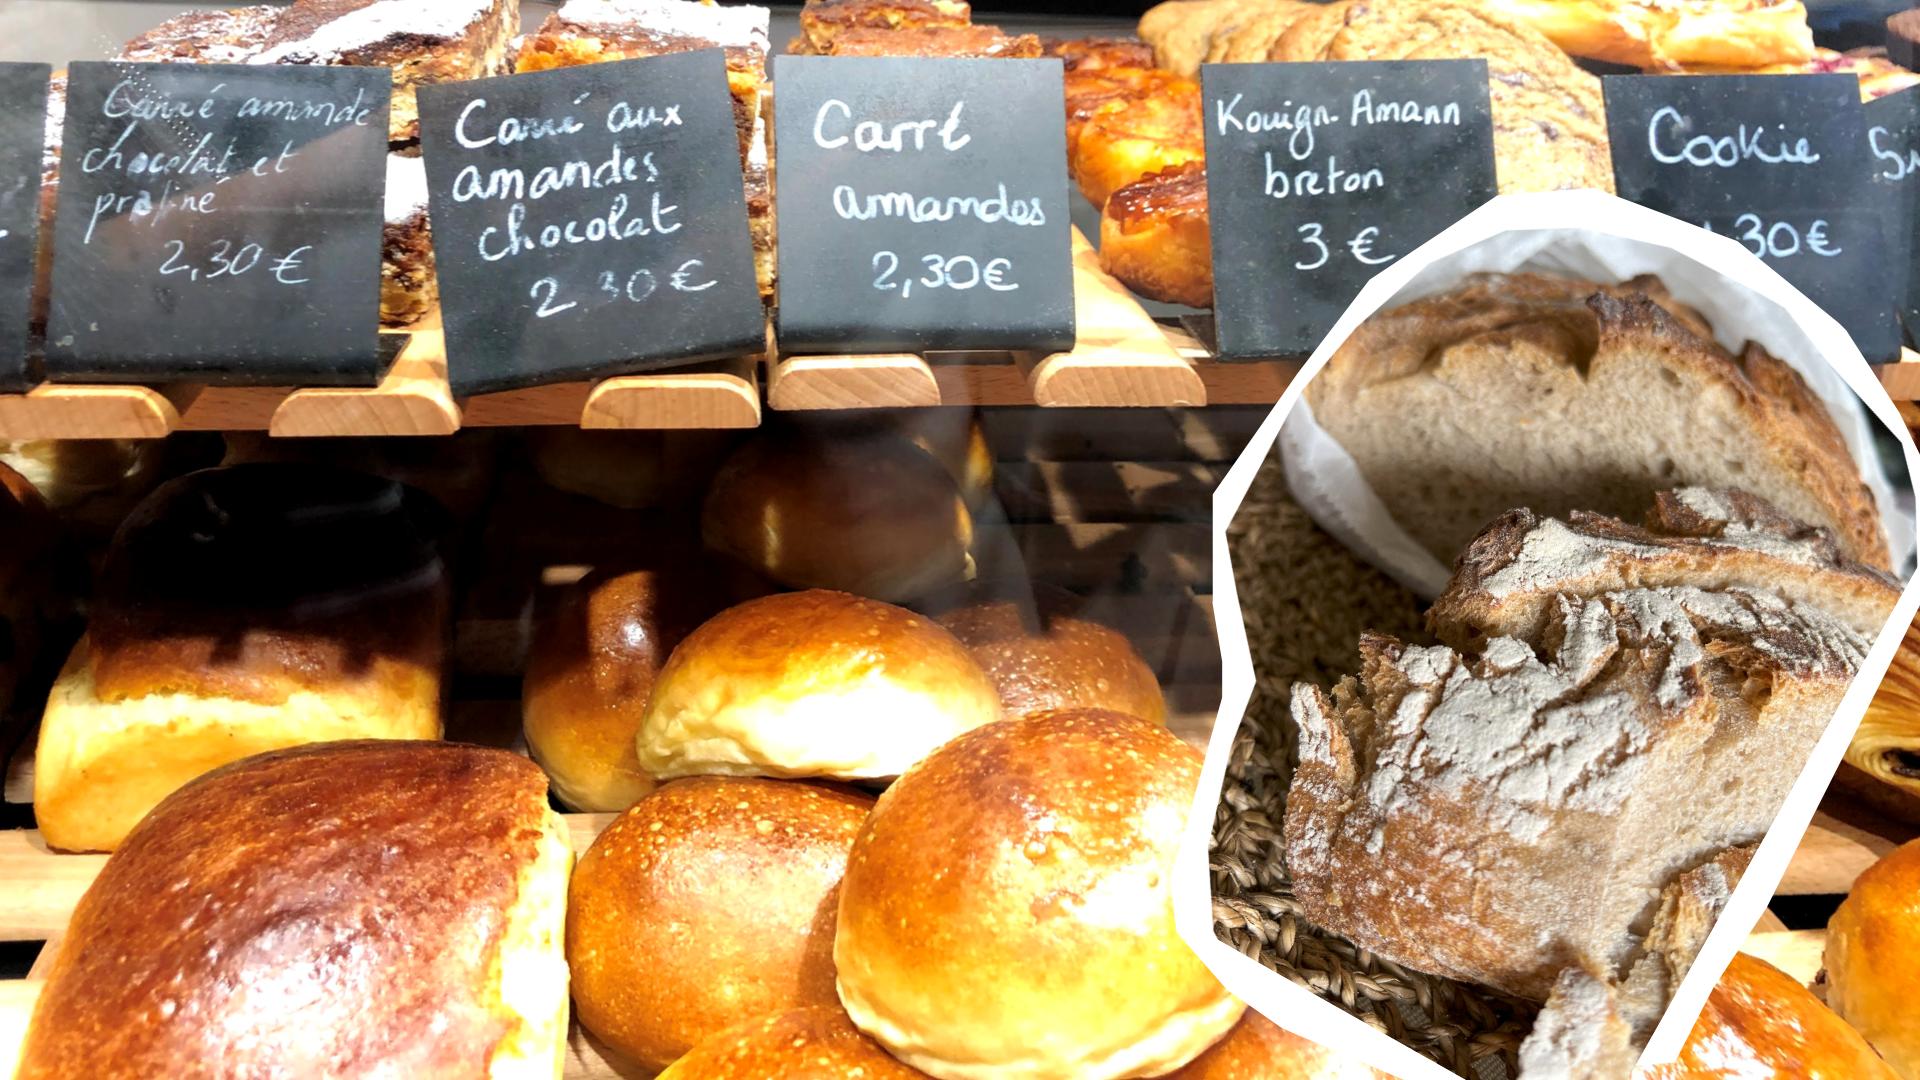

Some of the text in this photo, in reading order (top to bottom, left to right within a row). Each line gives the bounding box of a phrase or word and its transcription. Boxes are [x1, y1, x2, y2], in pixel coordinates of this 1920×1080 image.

[103, 79, 227, 119] Carré
[455, 92, 683, 148] Carré aux
[813, 99, 971, 151] Carré
[82, 121, 297, 176] chocolat et
[1648, 106, 1820, 167] Cookie
[452, 144, 659, 202] amandes
[1264, 151, 1384, 198] breton
[478, 192, 681, 261] chocolat
[833, 182, 1045, 226] amandes
[1295, 222, 1328, 270] 3
